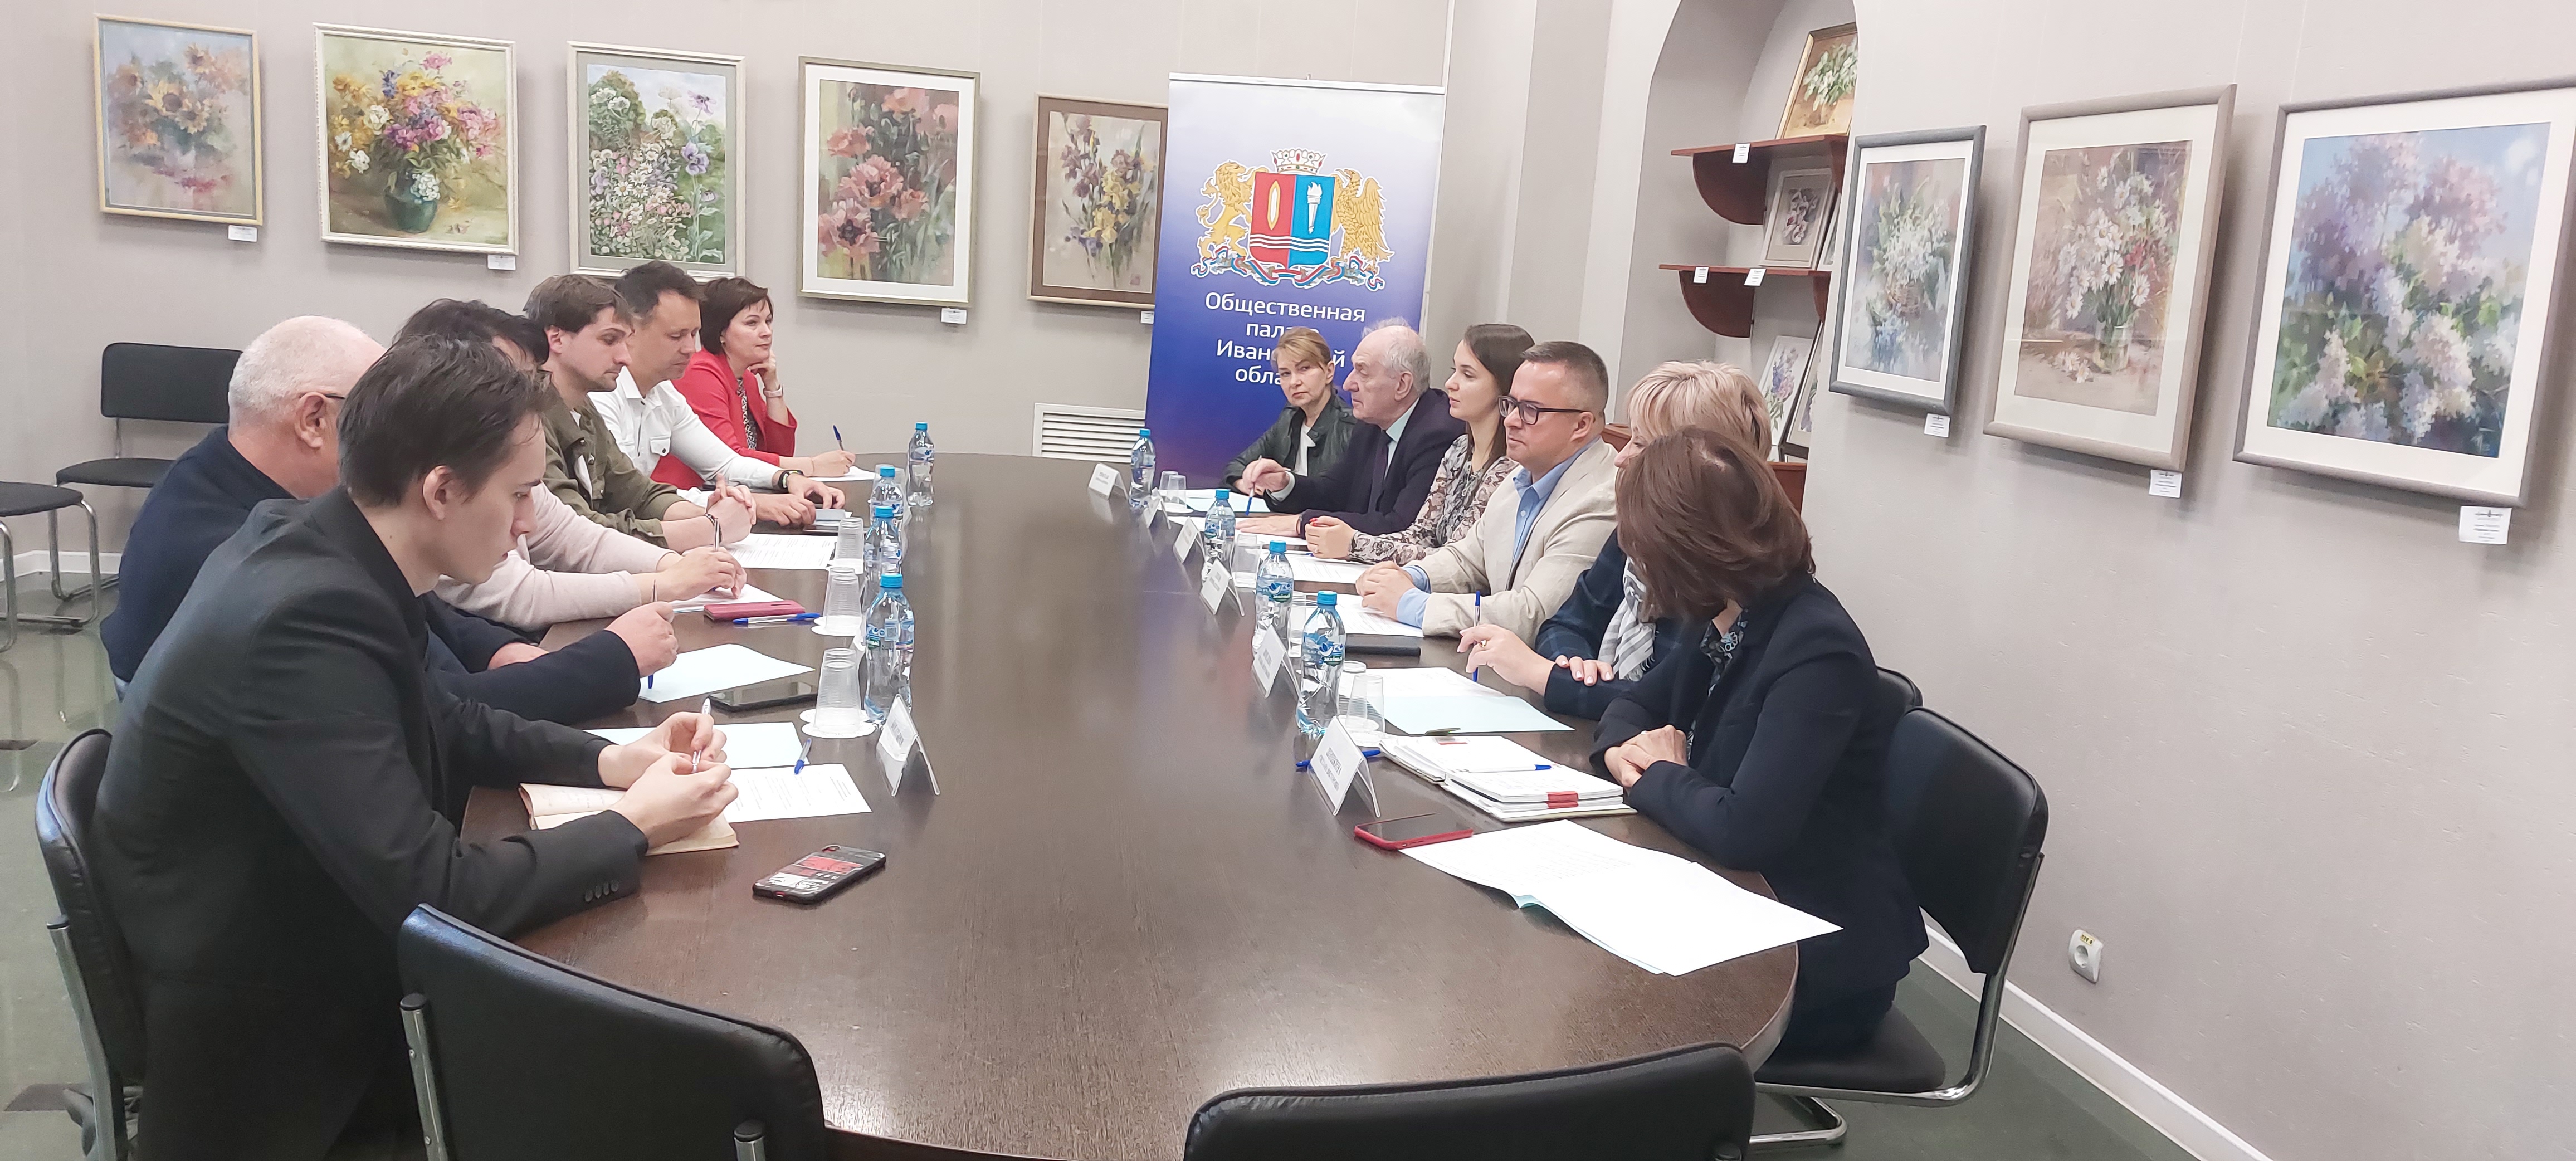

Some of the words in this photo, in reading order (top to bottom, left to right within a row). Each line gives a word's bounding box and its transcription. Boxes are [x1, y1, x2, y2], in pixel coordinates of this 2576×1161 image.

[1205, 291, 1365, 323] Общественная
[1216, 339, 1345, 368] Иванй
[1235, 365, 1282, 385] обла
